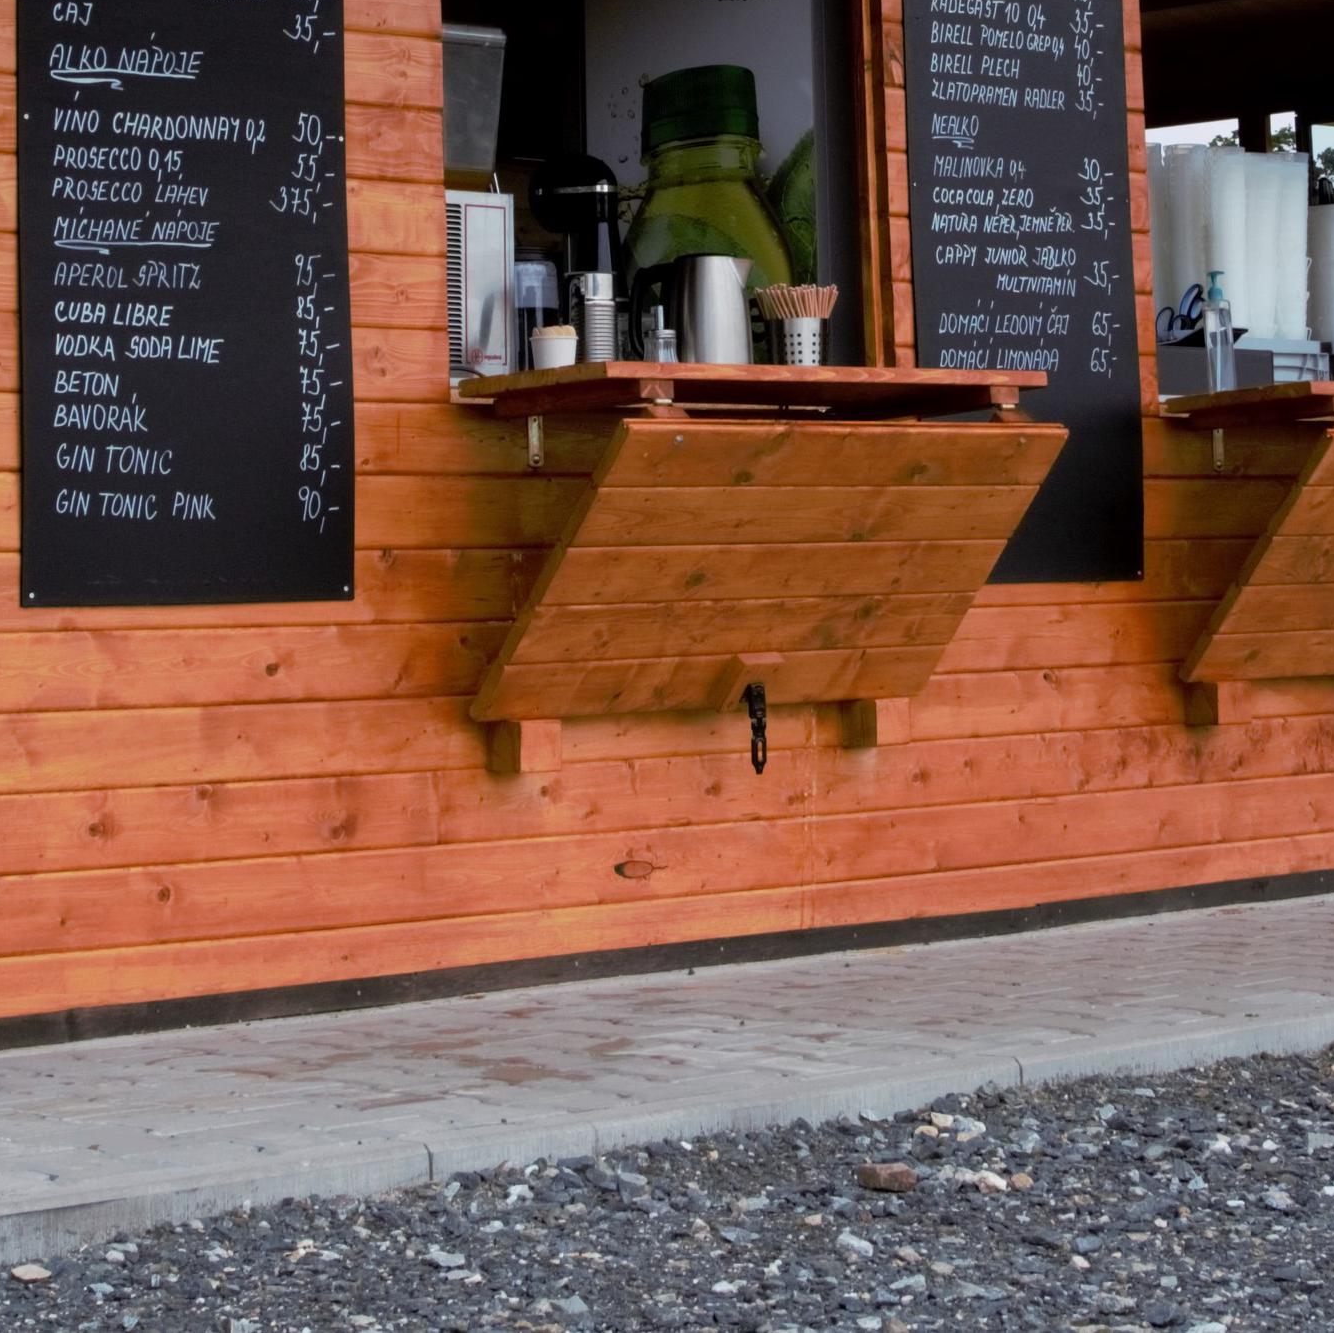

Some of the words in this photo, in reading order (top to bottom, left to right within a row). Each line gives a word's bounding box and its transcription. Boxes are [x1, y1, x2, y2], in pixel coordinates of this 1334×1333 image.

[1005, 2, 1020, 23] 10
[1028, 5, 1045, 32] 0,4
[931, 22, 973, 46] BIRELL
[981, 25, 1023, 49] POMELO
[1027, 33, 1051, 52] GREP
[50, 44, 107, 71] ALKO
[119, 32, 204, 74] NÁPOJE
[930, 53, 973, 75] BIRELL
[981, 56, 1020, 79] PLECH
[931, 79, 1017, 107] ZLATOPRAMEN
[1024, 88, 1065, 111] RADLER
[53, 90, 99, 133] VÍNO
[113, 112, 240, 141] CHARDONNAY
[246, 121, 265, 154] 0,2
[931, 114, 979, 136] NEALKO
[53, 145, 140, 170] PROSECCO
[933, 155, 1003, 178] MALINOVKA
[52, 179, 142, 203] PROSECCO
[155, 170, 208, 206] LÁHEV
[1002, 188, 1033, 208] ZERO
[54, 207, 149, 241] MÍCHANÉ
[152, 209, 220, 242] NÁPOJE
[931, 213, 977, 233] NATURA
[936, 244, 977, 265] CAPPY
[985, 248, 1028, 266] JUNIOR
[1032, 247, 1076, 270] JABLKO
[54, 263, 128, 289] APEROL
[133, 261, 201, 290] SPRITZ
[997, 269, 1076, 297] MULTIVITAMÍN
[55, 302, 105, 324] CUBA
[114, 302, 173, 327] LIBRE
[939, 299, 993, 334] DOMÁCÍ
[995, 302, 1043, 335] LEDOVÝ
[1047, 306, 1069, 335] ČAJ
[55, 334, 115, 361] VODKA
[125, 335, 172, 359] SODA
[178, 338, 224, 364] LIME
[940, 337, 993, 368] DOMÁCÍ
[997, 338, 1058, 372] LIMONÁDA
[54, 371, 119, 398] BETON
[54, 393, 148, 432] BAVORÁK
[56, 443, 96, 472] GIN
[106, 446, 172, 475] TONIC
[56, 489, 90, 518] GIN
[99, 492, 157, 520] TONIC
[173, 492, 216, 520] PINK
